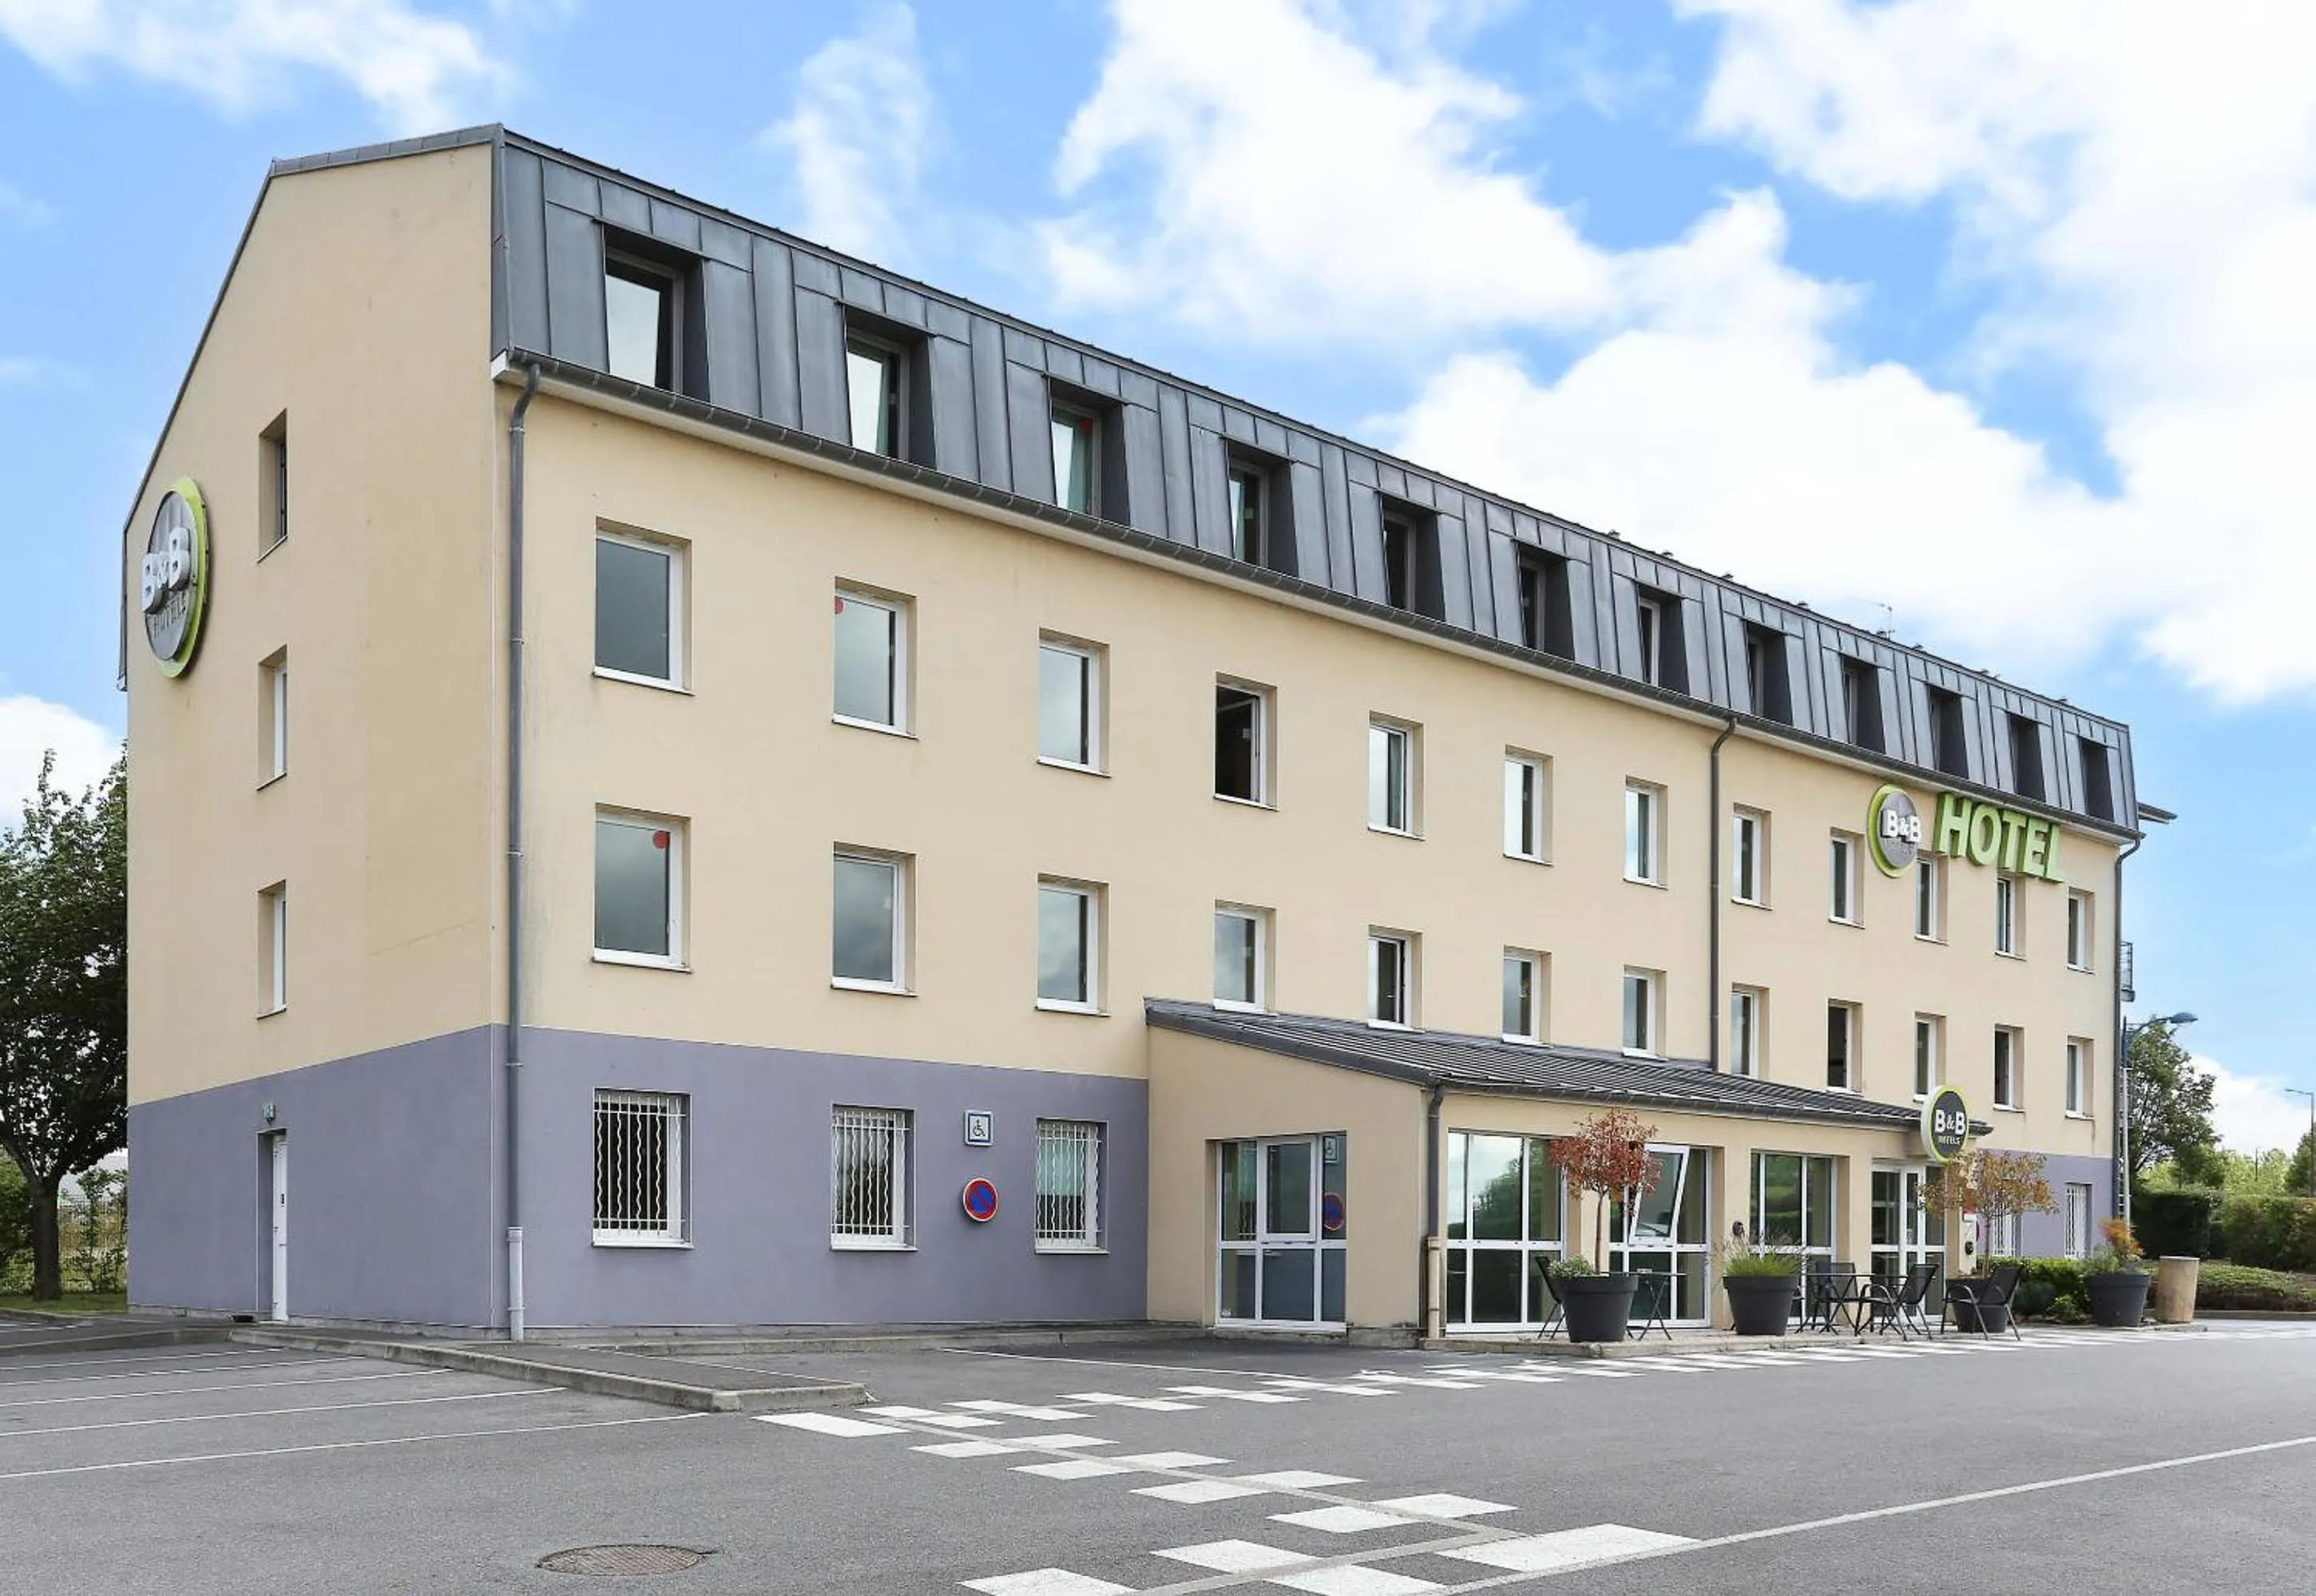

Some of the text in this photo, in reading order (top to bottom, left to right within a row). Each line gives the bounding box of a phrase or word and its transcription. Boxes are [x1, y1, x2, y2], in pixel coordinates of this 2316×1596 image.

[141, 527, 190, 613] B&B
[1882, 810, 1921, 843] B&B
[1936, 792, 2064, 883] HOTEL
[1934, 1109, 1965, 1135] B&B
